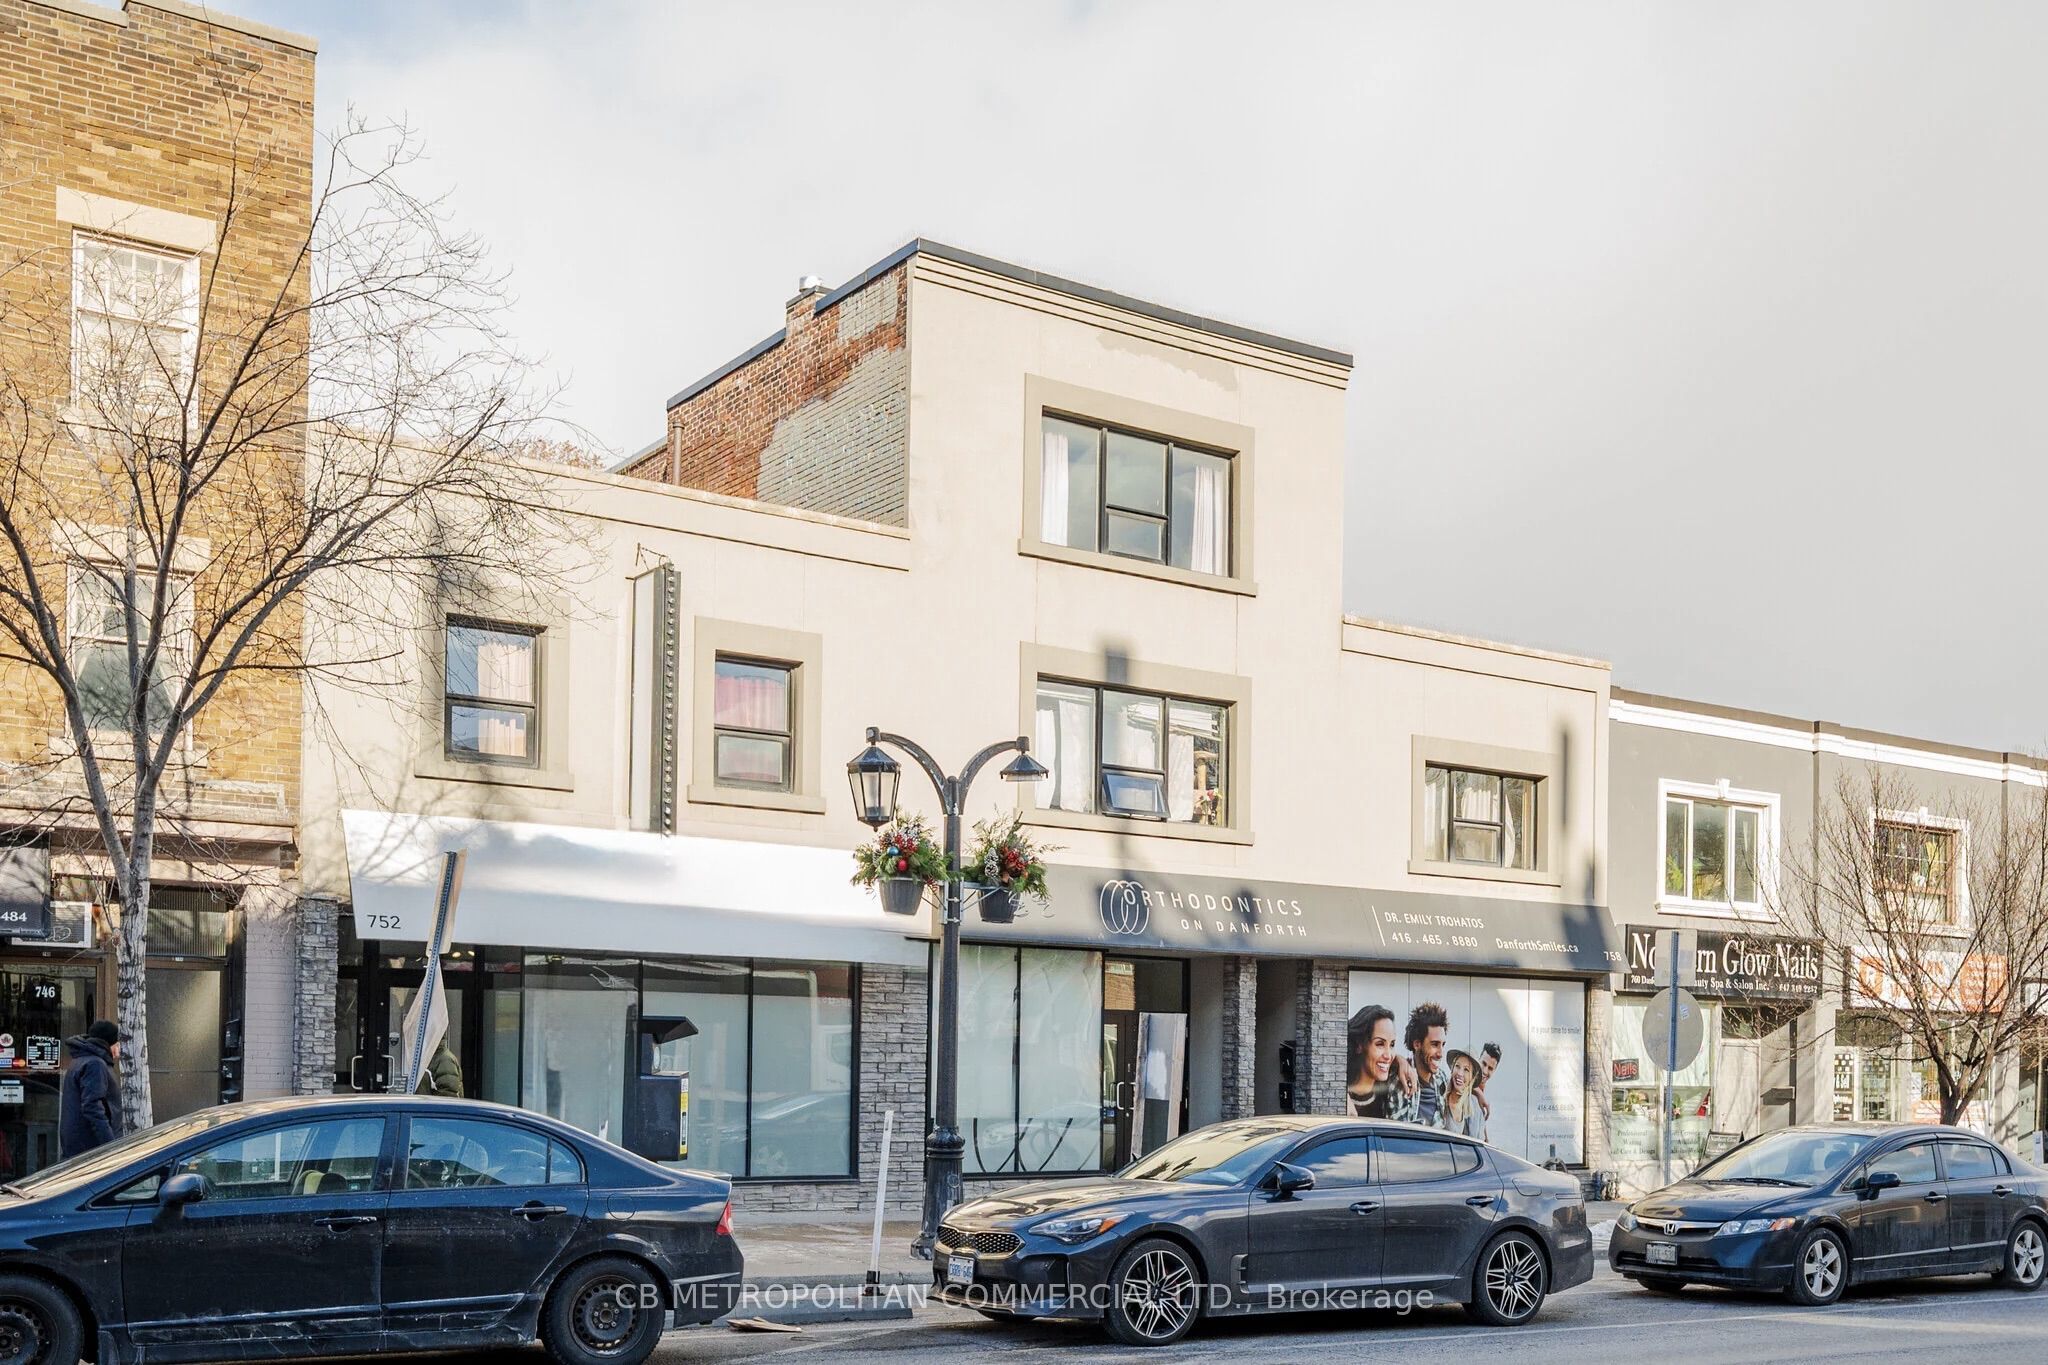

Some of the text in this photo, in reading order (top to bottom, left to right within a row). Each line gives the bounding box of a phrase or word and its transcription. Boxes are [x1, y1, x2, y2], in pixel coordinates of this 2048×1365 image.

[1124, 888, 1302, 916] ORTHODONTICS
[366, 914, 401, 930] 752
[1180, 919, 1307, 937] ON DANFORTH
[1384, 912, 1484, 929] DR. EMILY TROHATOS
[1391, 932, 1412, 944] 416
[1422, 934, 1442, 945] 465
[1452, 935, 1478, 947] 8880
[1495, 938, 1579, 953] DanforthSmiles.ca
[1603, 951, 1622, 961] 758
[1722, 939, 1773, 977] Glow
[1773, 943, 1819, 979] Nails
[1710, 978, 1724, 990] Spa
[1725, 979, 1732, 988] &
[1733, 981, 1754, 990] Salon
[1755, 982, 1770, 991] Inc.
[35, 987, 56, 998] 746
[1613, 1062, 1638, 1077] Nails
